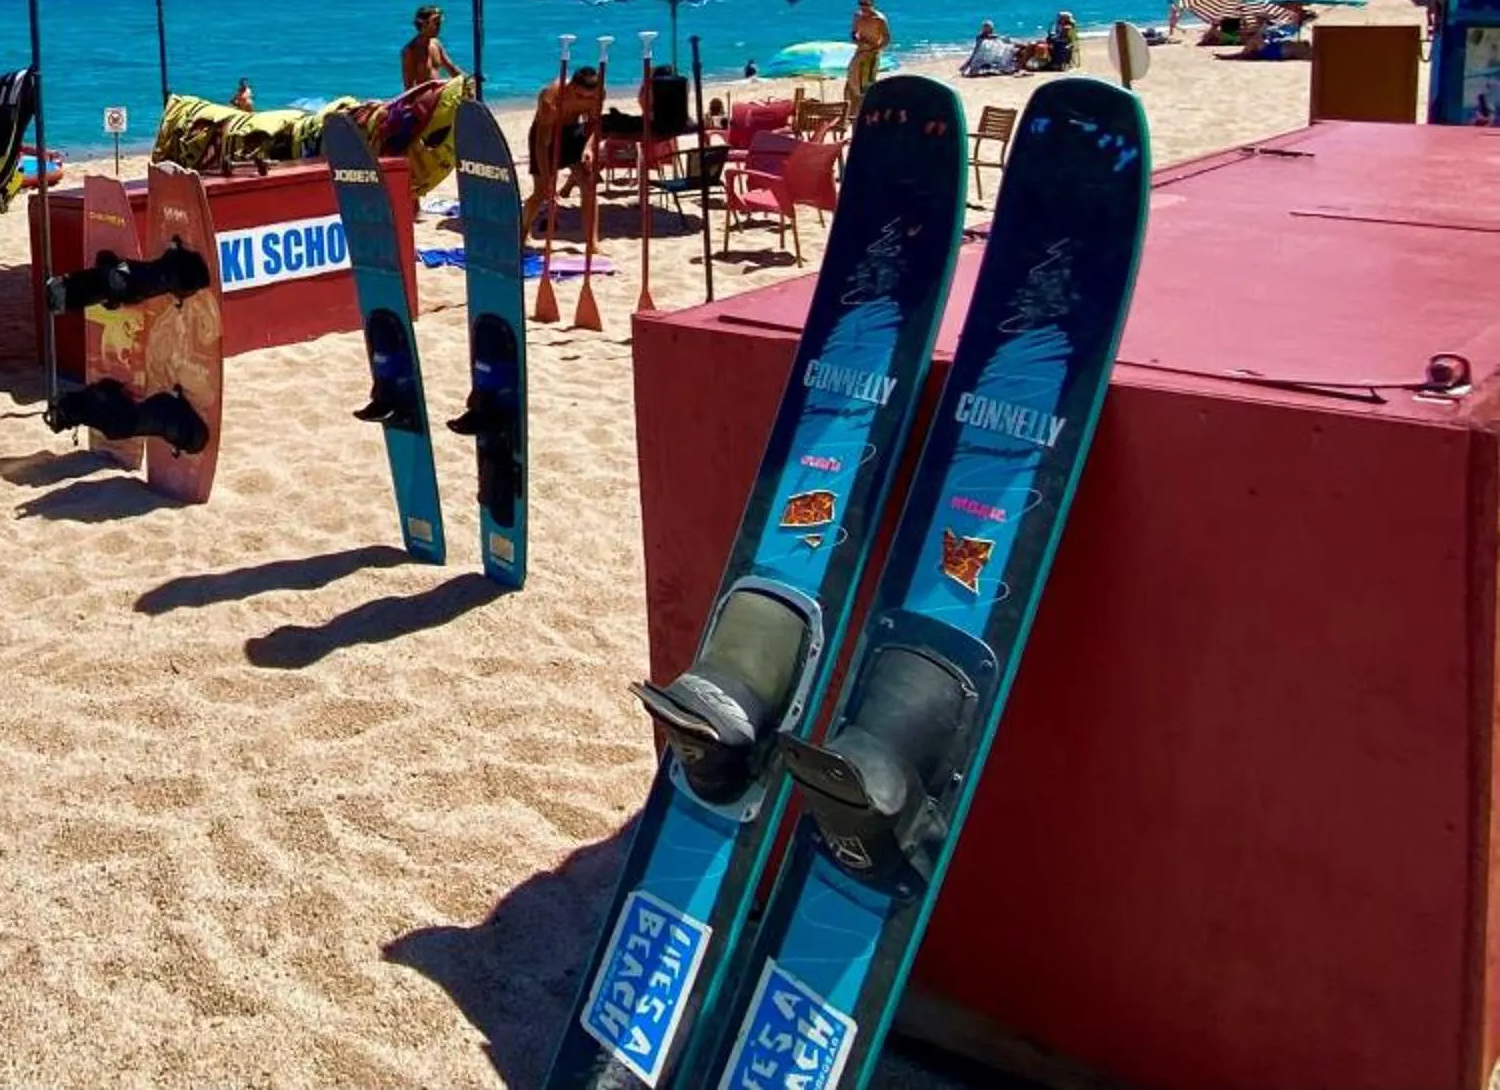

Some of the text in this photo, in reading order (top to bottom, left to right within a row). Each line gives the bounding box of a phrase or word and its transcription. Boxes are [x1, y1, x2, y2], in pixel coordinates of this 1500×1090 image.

[219, 221, 348, 284] KI SCHO
[803, 359, 898, 406] CONNELLY
[955, 392, 1067, 448] CONNELLY
[599, 908, 667, 1039] BEACH
[771, 989, 804, 1021] A
[624, 1025, 652, 1056] A
